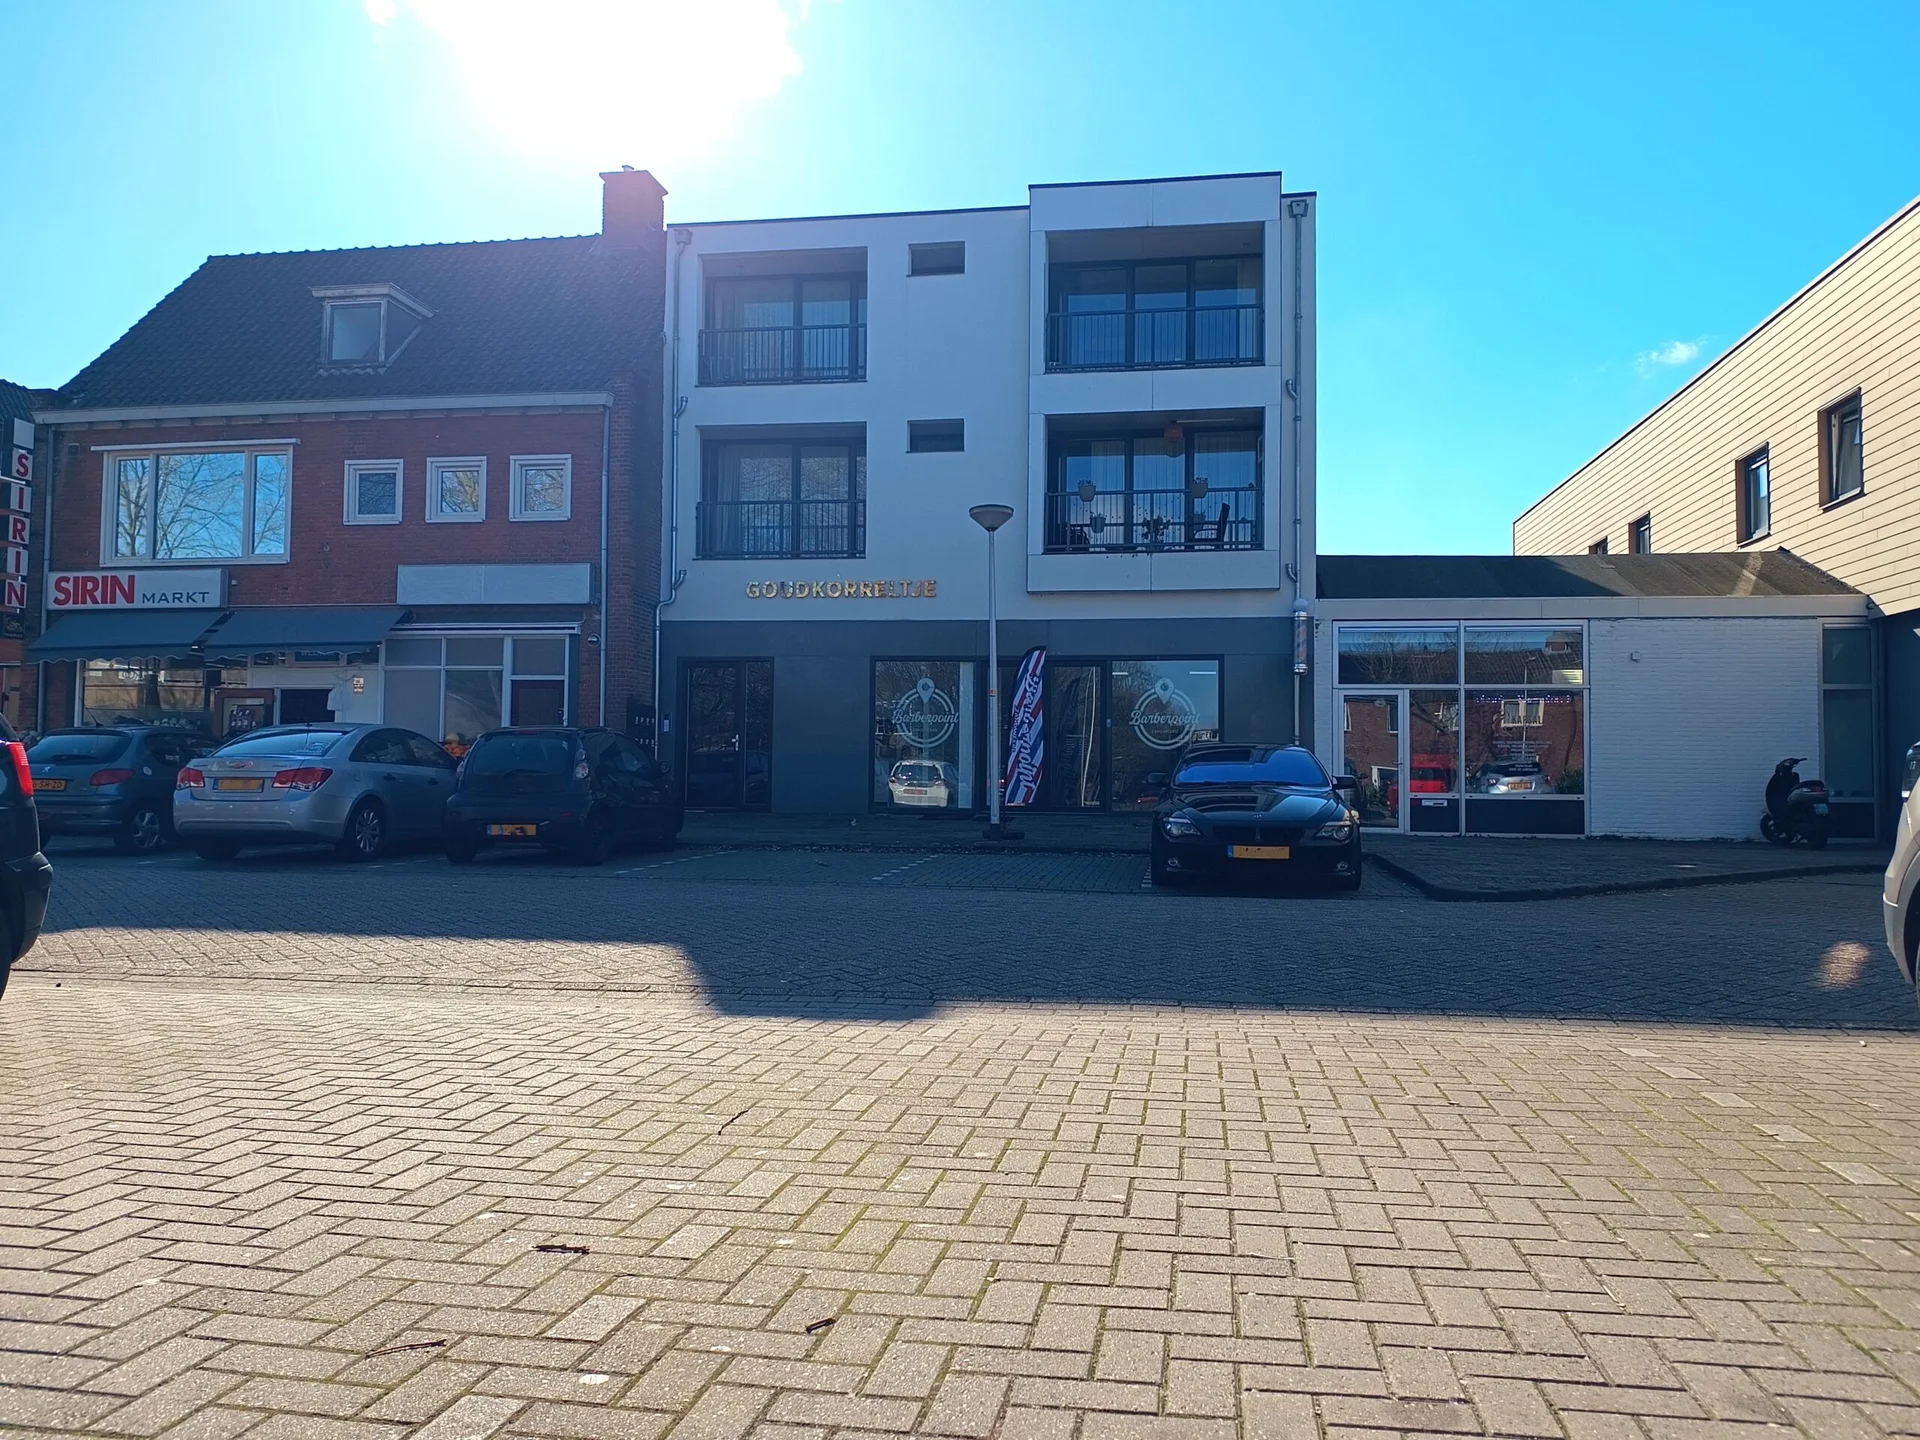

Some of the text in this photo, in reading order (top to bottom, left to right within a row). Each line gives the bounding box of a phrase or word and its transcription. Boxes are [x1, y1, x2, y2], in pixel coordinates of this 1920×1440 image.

[6, 453, 29, 607] SIRIN
[53, 574, 210, 606] SIRIN MARKT
[745, 579, 937, 599] GOUDKORRELTJE
[891, 709, 960, 725] Barberpoint
[1128, 709, 1201, 727] Barberpoint
